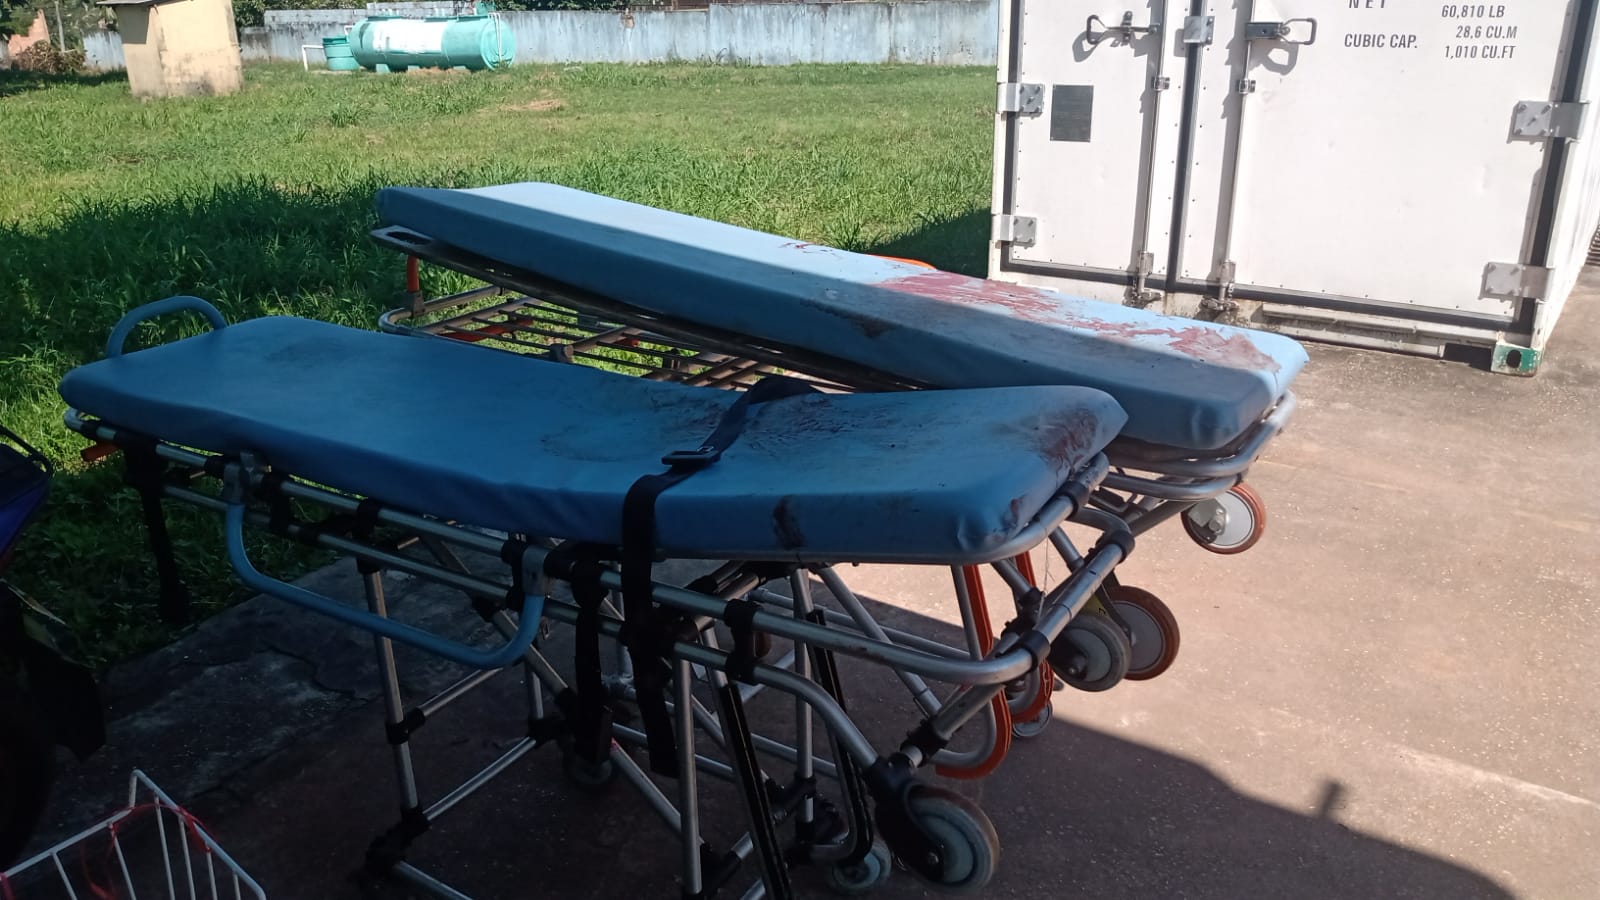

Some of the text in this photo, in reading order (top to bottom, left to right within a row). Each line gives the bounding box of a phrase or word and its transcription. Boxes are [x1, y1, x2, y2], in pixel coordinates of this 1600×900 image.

[1441, 4, 1505, 19] 60,810 LB
[1485, 25, 1518, 39] CU.M
[1344, 33, 1418, 49] CUBIC CAP.
[1445, 45, 1517, 59] 1,010 CU.FT
